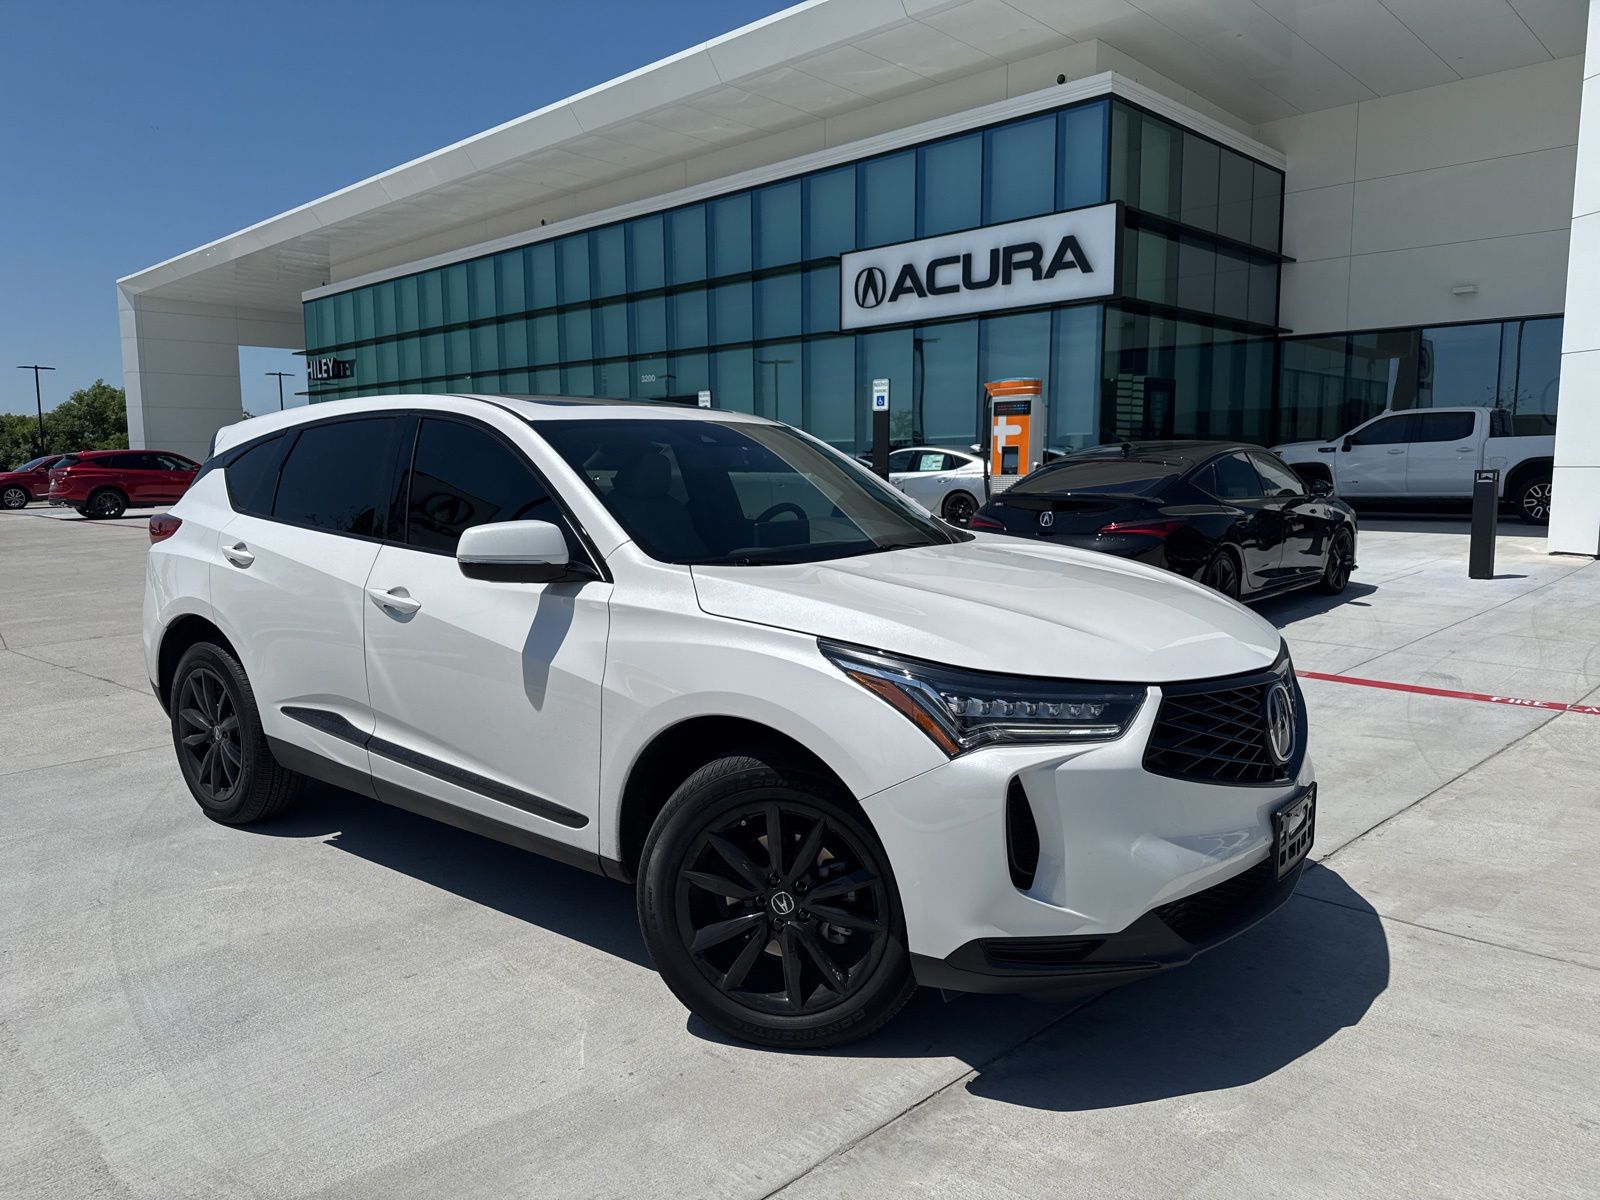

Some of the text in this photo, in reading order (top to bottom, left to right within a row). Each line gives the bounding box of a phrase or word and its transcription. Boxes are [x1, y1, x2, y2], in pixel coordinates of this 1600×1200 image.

[887, 234, 1094, 303] ACURA
[306, 357, 334, 379] HILEY
[641, 374, 656, 383] 3200
